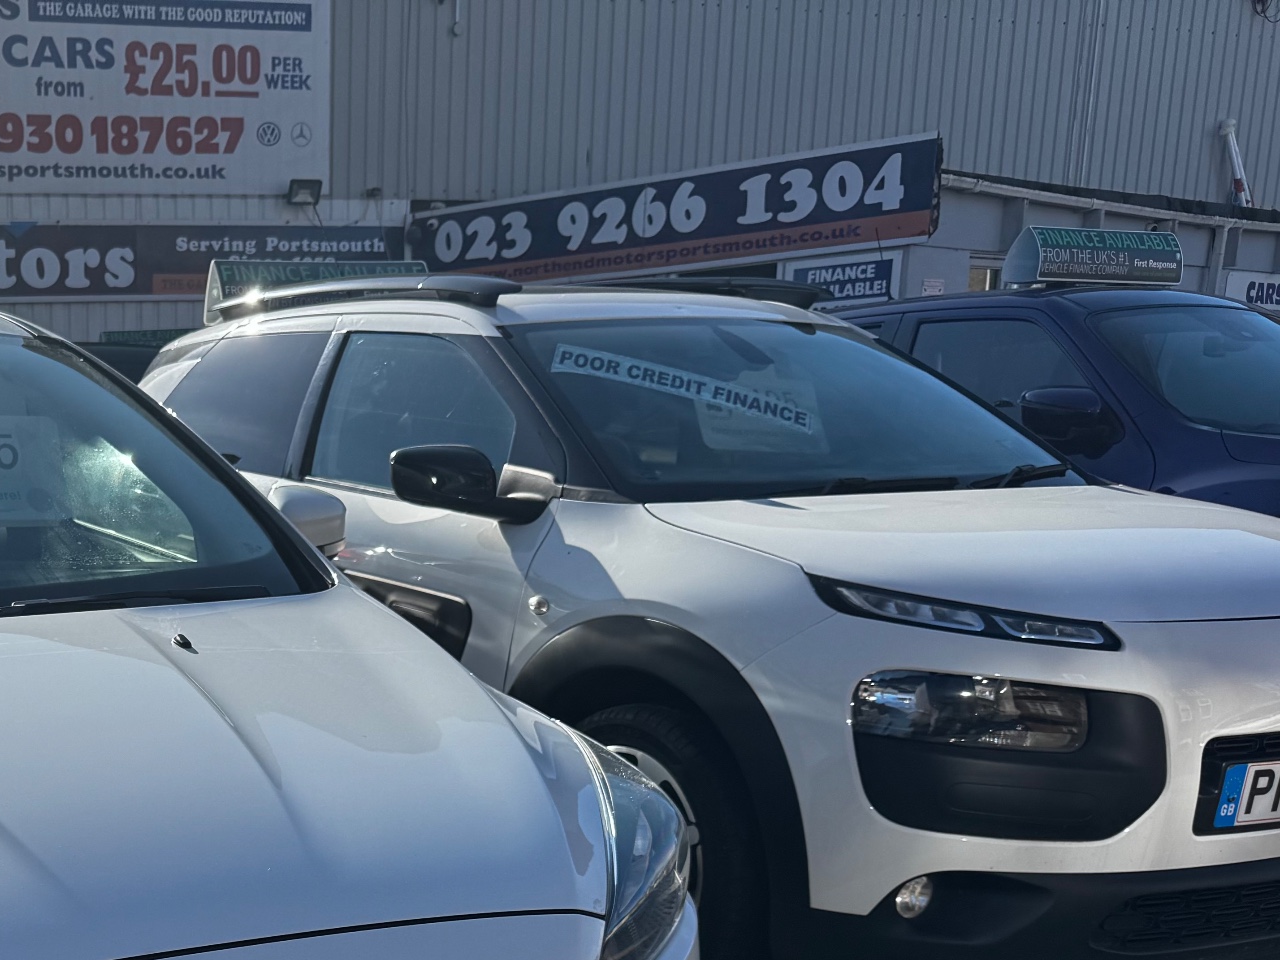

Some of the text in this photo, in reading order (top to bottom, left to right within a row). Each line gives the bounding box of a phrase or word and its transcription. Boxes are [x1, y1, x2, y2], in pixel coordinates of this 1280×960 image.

[37, 2, 306, 26] THE GARAGE WITH THE GOOD REPUTATION!
[2, 34, 116, 70] CARS
[124, 41, 261, 98] £25.00
[272, 56, 303, 73] PER
[35, 76, 85, 98] from
[264, 73, 312, 91] WEEK
[90, 115, 245, 155] 187627
[434, 152, 905, 264] 023 9266 1304
[175, 237, 385, 254] Serving Portsmouth
[481, 224, 862, 277] w.northendmotorsportsmouth.co.uk
[1035, 229, 1180, 251] FINANCE AVAILABLE
[1041, 248, 1071, 262] FROM
[1072, 249, 1092, 263] THE
[1119, 252, 1130, 265] #1
[1134, 259, 1177, 270] First Response
[220, 265, 313, 282] FINANCE
[807, 264, 877, 285] FINANCE
[1041, 262, 1068, 273] VEHICLE
[1070, 263, 1097, 274] FINANCE
[1097, 264, 1130, 275] COMPANY
[558, 350, 620, 376] POOR
[626, 364, 706, 395] CREDIT
[712, 386, 808, 428] FINANCE
[1244, 769, 1280, 815] P
[1221, 803, 1236, 816] GB
